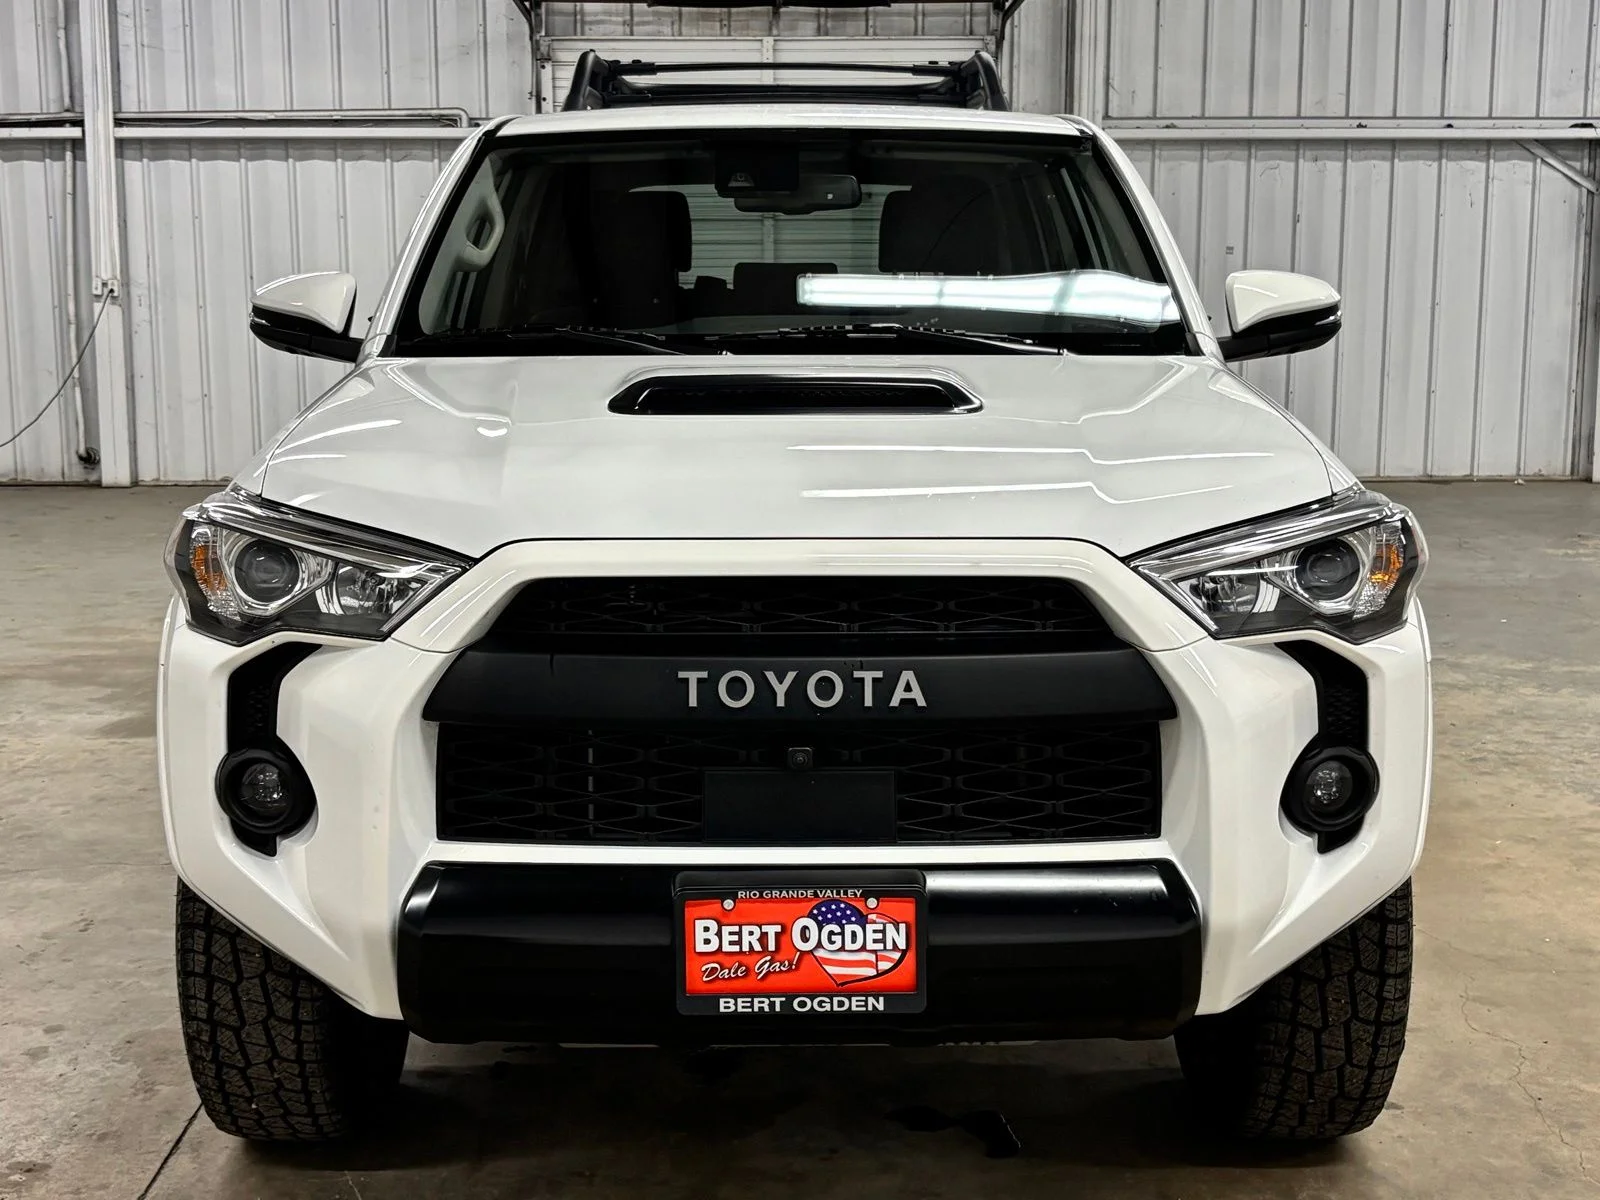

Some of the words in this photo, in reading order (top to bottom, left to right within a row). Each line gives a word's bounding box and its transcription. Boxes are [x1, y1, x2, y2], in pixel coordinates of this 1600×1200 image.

[677, 670, 928, 708] TOYOTA
[738, 891, 760, 899] RIO
[763, 890, 814, 899] GRANDE
[818, 889, 862, 898] VALLEY
[701, 962, 747, 982] Dale
[754, 951, 800, 980] Gas!
[719, 997, 786, 1013] BERT
[792, 996, 885, 1012] OGDEN
